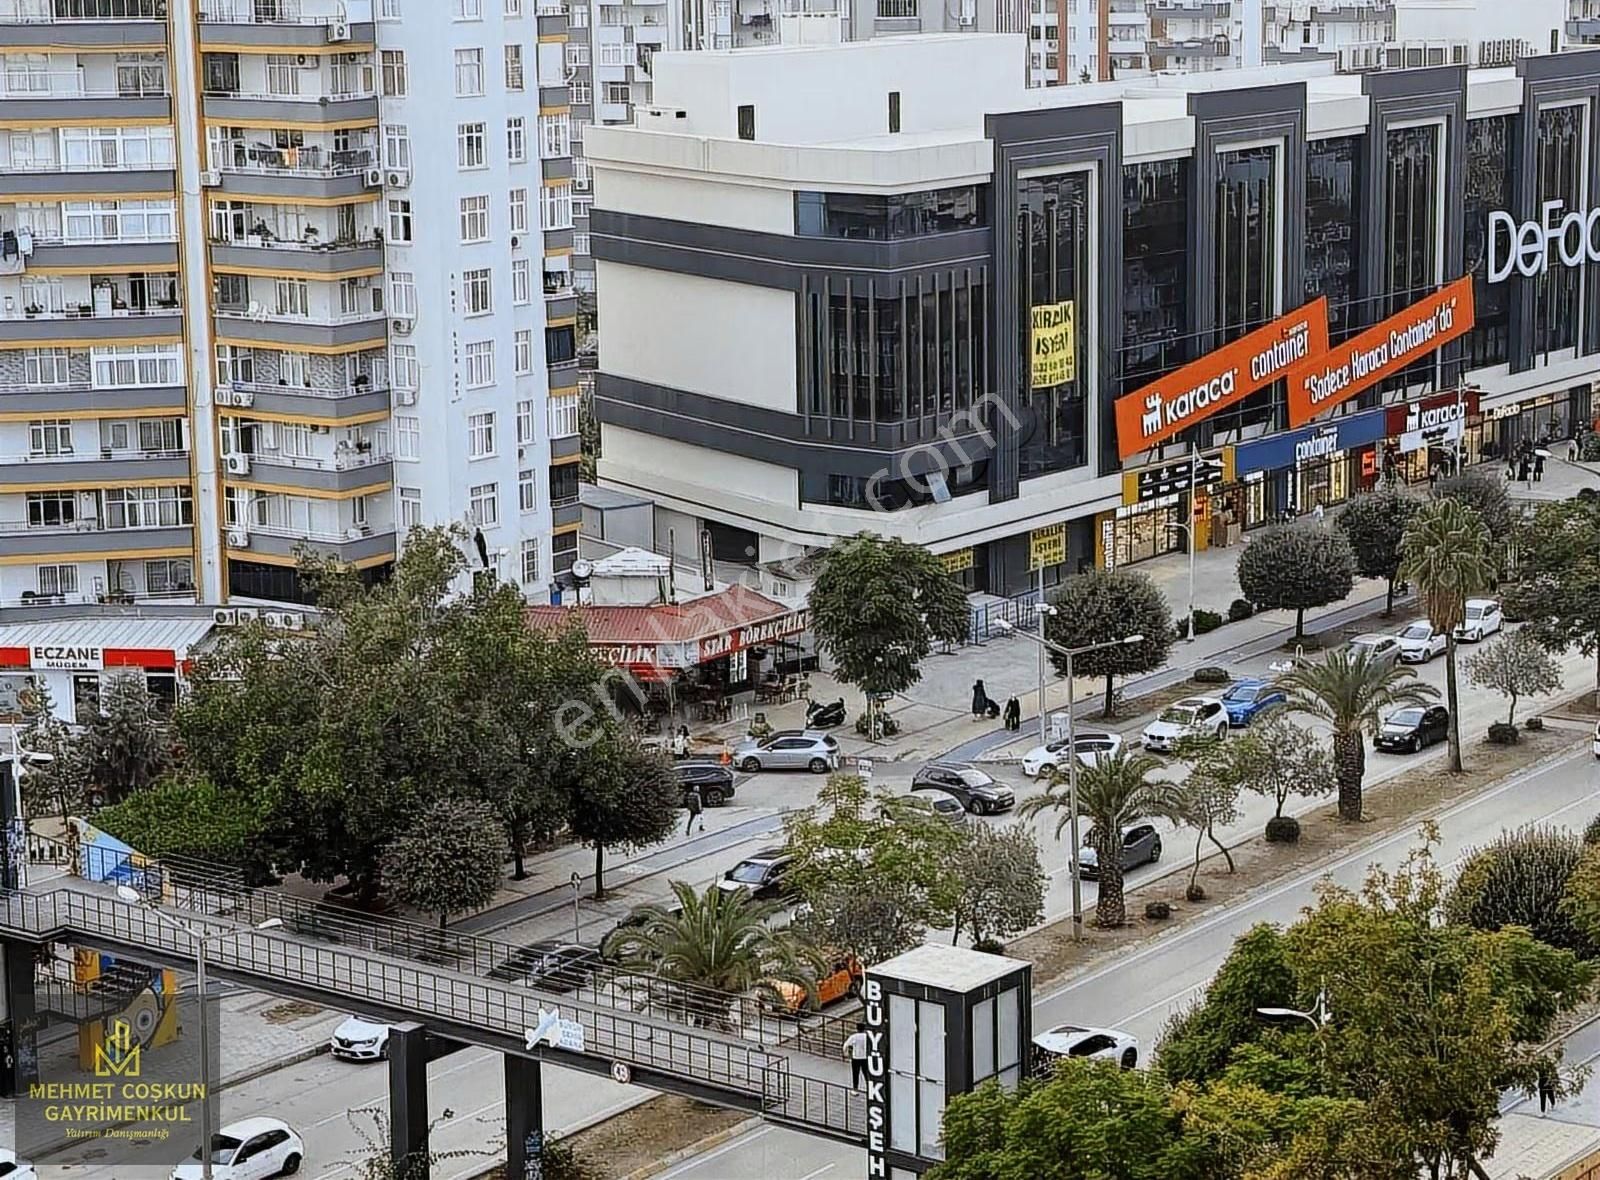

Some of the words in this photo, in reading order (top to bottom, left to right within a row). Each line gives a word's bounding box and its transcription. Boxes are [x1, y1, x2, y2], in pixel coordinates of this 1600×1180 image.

[1351, 342, 1388, 381] Karaca
[1166, 369, 1236, 425] karaca
[1251, 330, 1310, 381] container
[1421, 402, 1466, 428] karaca
[1296, 433, 1338, 460] container
[34, 646, 100, 661] ECZANE
[703, 634, 732, 657] STAR
